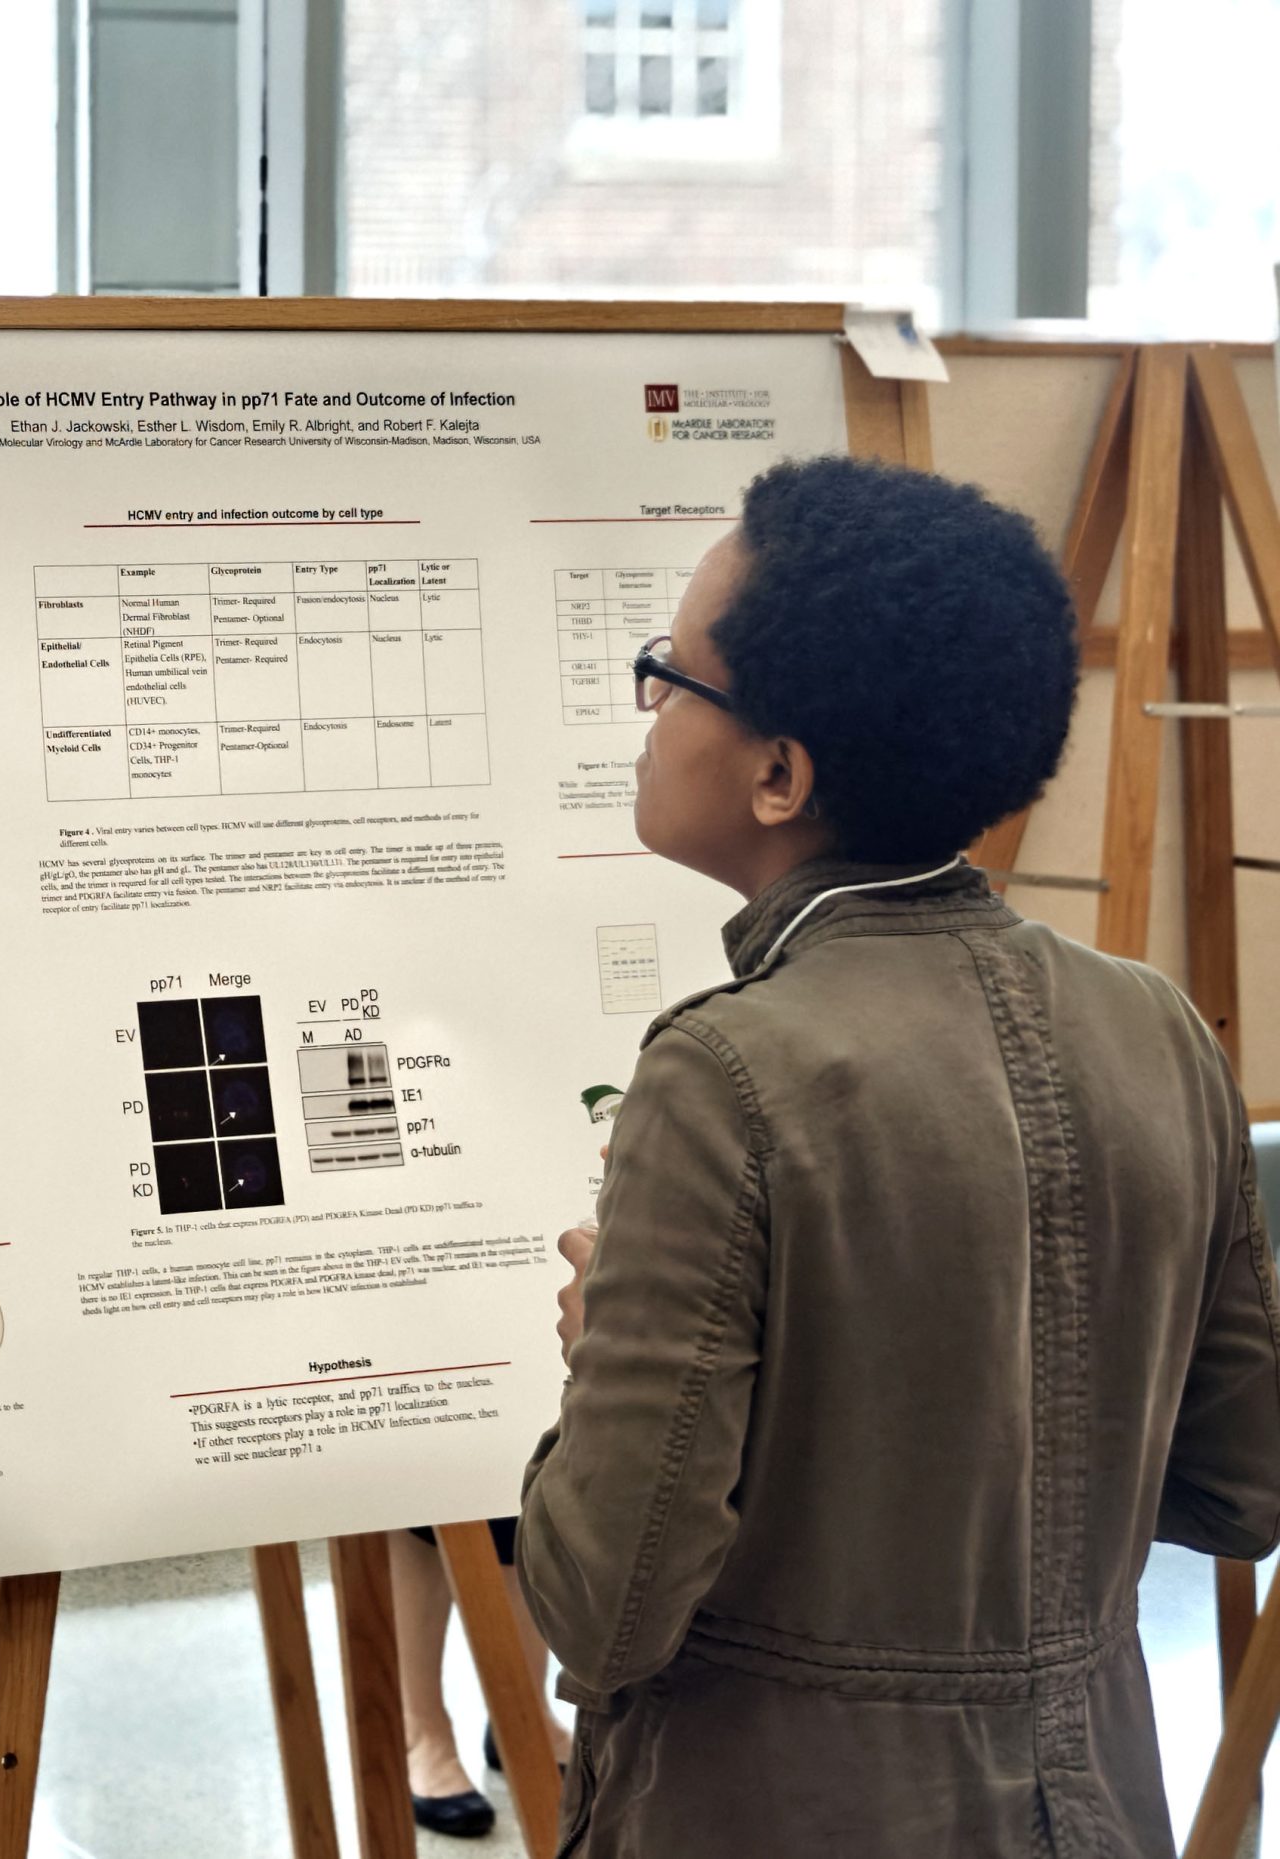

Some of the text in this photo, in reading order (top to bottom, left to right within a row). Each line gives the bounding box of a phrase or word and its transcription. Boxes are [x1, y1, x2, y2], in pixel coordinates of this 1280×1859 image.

[24, 391, 41, 406] of
[46, 391, 96, 406] HCMV
[101, 391, 144, 410] Entry
[149, 391, 217, 410] Pathway
[221, 395, 236, 406] in
[241, 391, 278, 409] pp71
[284, 391, 318, 406] Fate
[322, 391, 351, 406] and
[356, 391, 425, 406] Outcome
[430, 391, 445, 406] of
[449, 391, 515, 406] Infection
[647, 389, 676, 407] IMV
[10, 418, 479, 434] Ethan J. Jackowski, Esther L. Wisdom, Emily R. Albright, and Robert F. Kalejta
[45, 437, 83, 449] Virology
[85, 438, 102, 447] and
[104, 437, 142, 446] McArdle
[144, 437, 193, 448] Laboratory
[195, 436, 207, 446] for
[209, 436, 242, 446] Cancer
[243, 436, 286, 446] Research
[288, 436, 332, 447] University
[333, 435, 343, 445] of
[344, 435, 430, 445] Wisconsin-Madison,
[432, 435, 471, 445] Madison,
[472, 435, 518, 444] Wisconsin,
[521, 435, 541, 444] USA
[672, 431, 774, 440] FOR CANCER RESEARCH
[127, 507, 383, 522] HCMV entry and infection outcome by cell type
[639, 504, 725, 517] Target Receptors
[120, 567, 155, 578] Example
[211, 566, 261, 576] Glycoprotein
[295, 564, 338, 574] Entry Type
[368, 563, 386, 574] pp71
[421, 562, 440, 572] Lytic
[422, 576, 446, 584] Latent
[38, 600, 83, 608] Fibroblasts
[121, 598, 179, 607] Normal Human
[123, 639, 183, 650] Retinal Pigment
[42, 659, 110, 668] Endothelial Cells
[45, 728, 111, 739] Undifferentiated
[47, 743, 101, 754] Myeloid Cells
[149, 972, 251, 992] pp71 Merge
[361, 988, 378, 1001] PD
[308, 997, 359, 1013] EV PD
[362, 1004, 379, 1020] KD
[115, 1028, 135, 1042] EV
[302, 1027, 362, 1043] M AD
[401, 1088, 422, 1102] IE1
[123, 1100, 143, 1114] PD
[406, 1117, 435, 1134] pp71
[129, 1162, 150, 1176] PD
[132, 1183, 153, 1197] KD
[308, 1356, 372, 1374] Hypothesis
[190, 1420, 213, 1432] This
[214, 1418, 256, 1431] suggests
[258, 1413, 303, 1426] receptors
[304, 1409, 325, 1423] play
[327, 1410, 334, 1418] a
[335, 1405, 354, 1417] role
[368, 1401, 391, 1416] pp71
[394, 1398, 448, 1411] localization
[194, 1442, 322, 1464] we will see nuclear pp71 a
